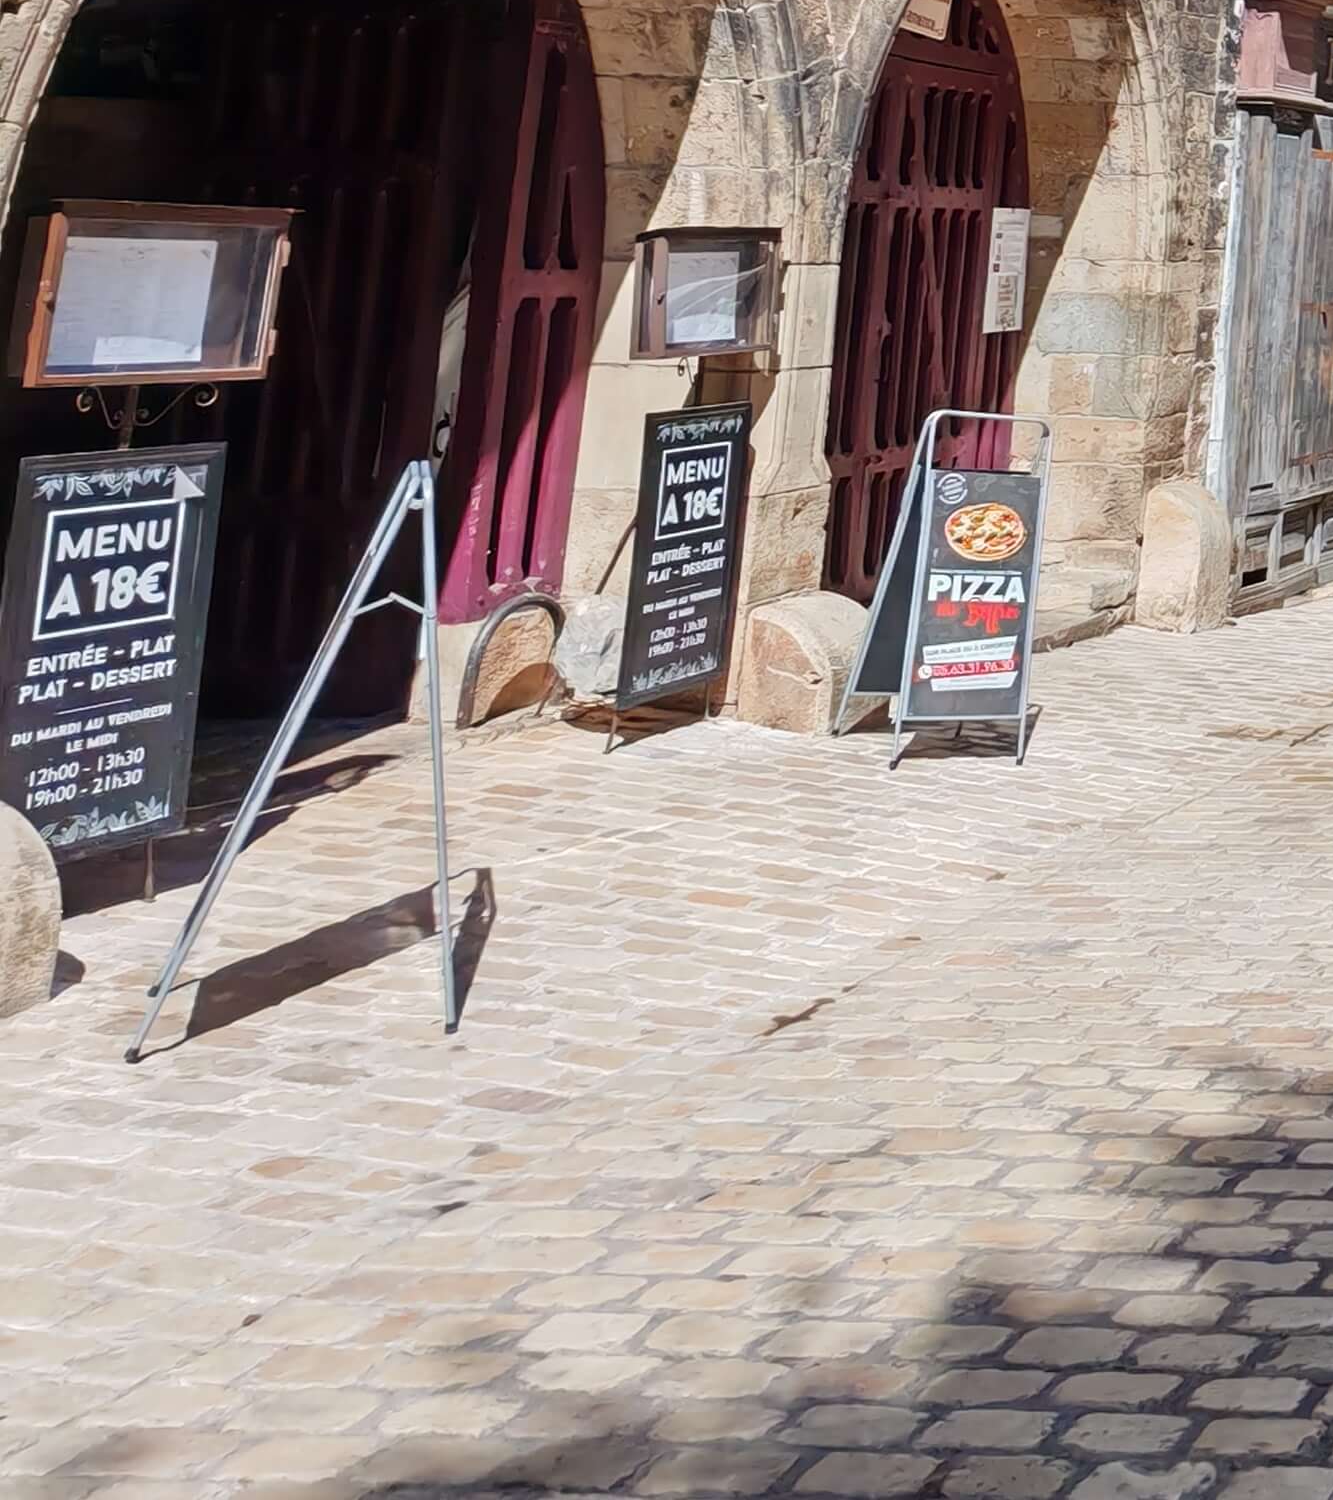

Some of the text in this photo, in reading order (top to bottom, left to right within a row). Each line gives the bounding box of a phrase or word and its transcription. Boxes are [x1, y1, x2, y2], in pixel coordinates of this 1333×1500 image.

[666, 457, 725, 486] MENU
[660, 486, 723, 527] A 18€
[56, 518, 172, 562] MENU
[45, 561, 170, 620] A 18€
[927, 573, 1025, 603] PIZZA
[25, 644, 109, 677] ENTRÉE
[130, 634, 176, 659] PLAT
[18, 679, 67, 705] PLAT
[90, 659, 177, 691] DESSERT
[10, 731, 32, 747] DU
[36, 721, 82, 741] MARDI
[84, 716, 104, 731] AU
[65, 738, 83, 754] LE
[28, 762, 80, 788] 12h00
[97, 747, 145, 772] 13h30
[25, 783, 77, 810] 19h00
[92, 769, 144, 794] 21h30
